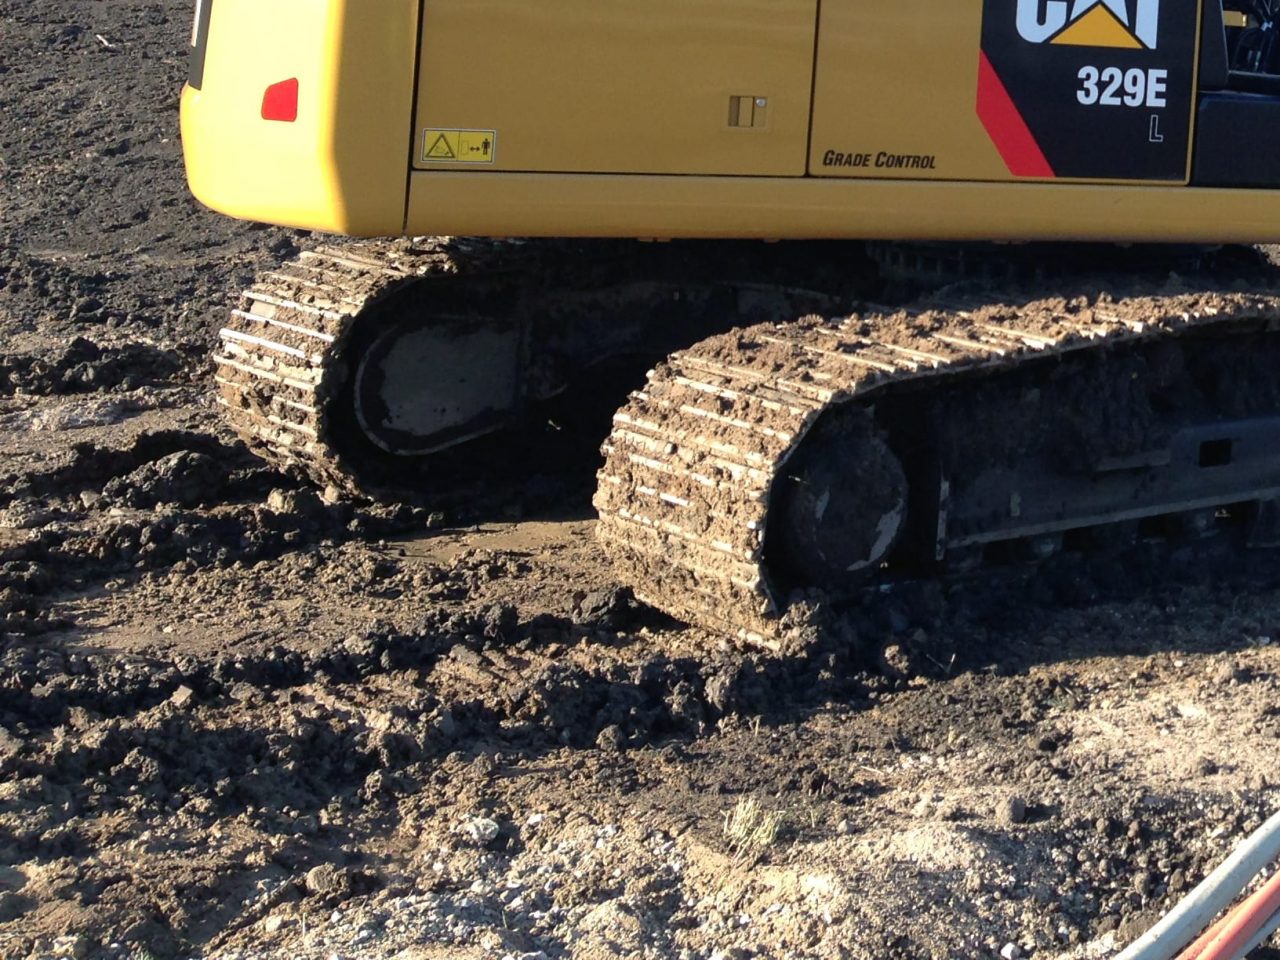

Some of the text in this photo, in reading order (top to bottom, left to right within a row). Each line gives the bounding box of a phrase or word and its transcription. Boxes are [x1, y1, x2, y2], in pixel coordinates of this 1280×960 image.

[1076, 65, 1168, 108] 329E
[1149, 114, 1164, 142] L
[822, 149, 936, 169] GRADE CONTROL
